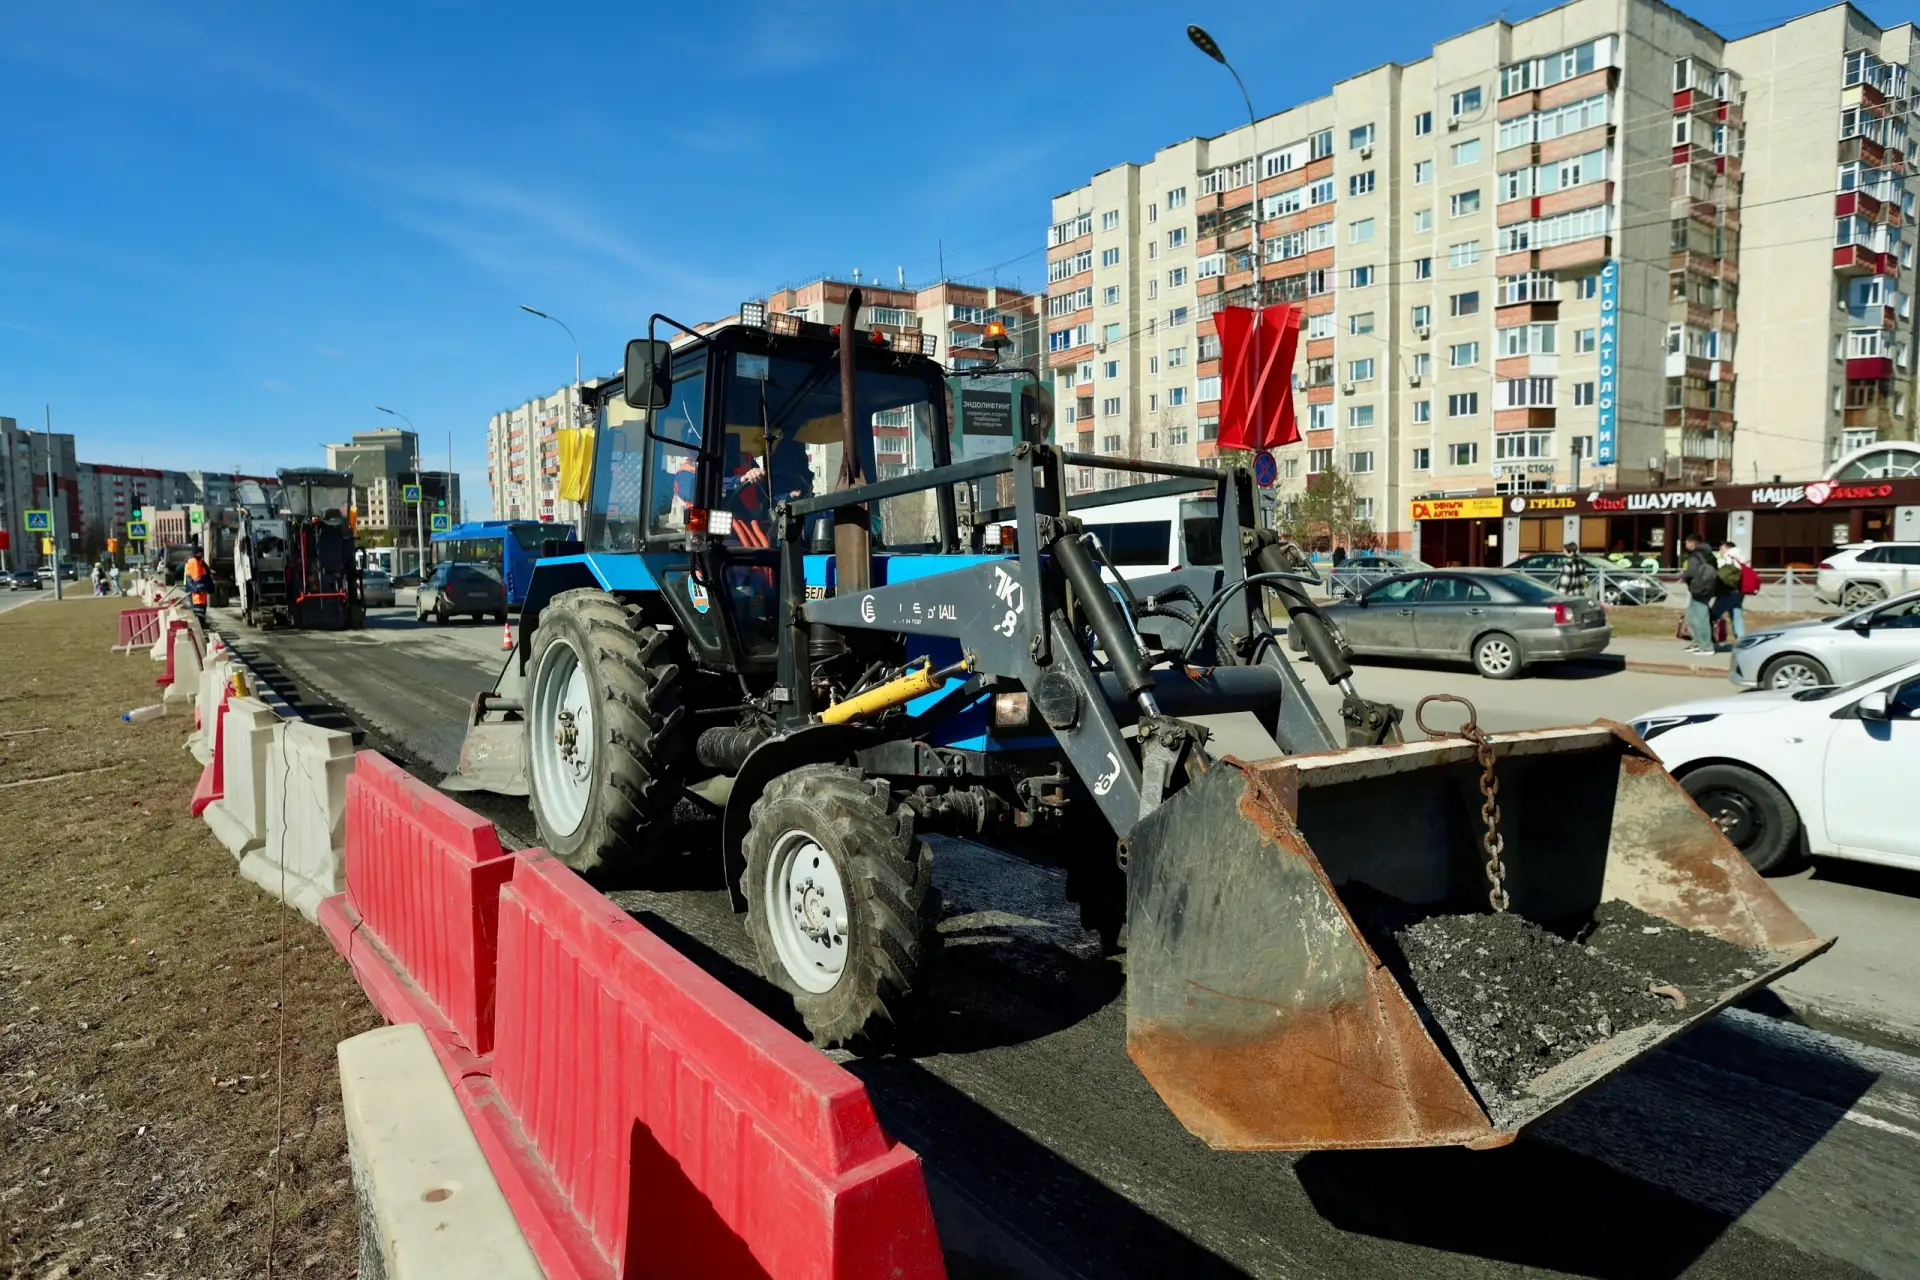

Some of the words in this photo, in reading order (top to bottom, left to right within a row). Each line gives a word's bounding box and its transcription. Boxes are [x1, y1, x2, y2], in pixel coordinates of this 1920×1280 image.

[1600, 264, 1615, 460] СТОМАТОЛОГИЯ
[963, 400, 1010, 410] ЭНДОЛИФТИНГ
[1529, 499, 1577, 509] ГРИЛЬ
[1592, 498, 1626, 511] Chef
[1628, 492, 1717, 510] ШАУРМА
[1752, 486, 1804, 508] НАШЕ
